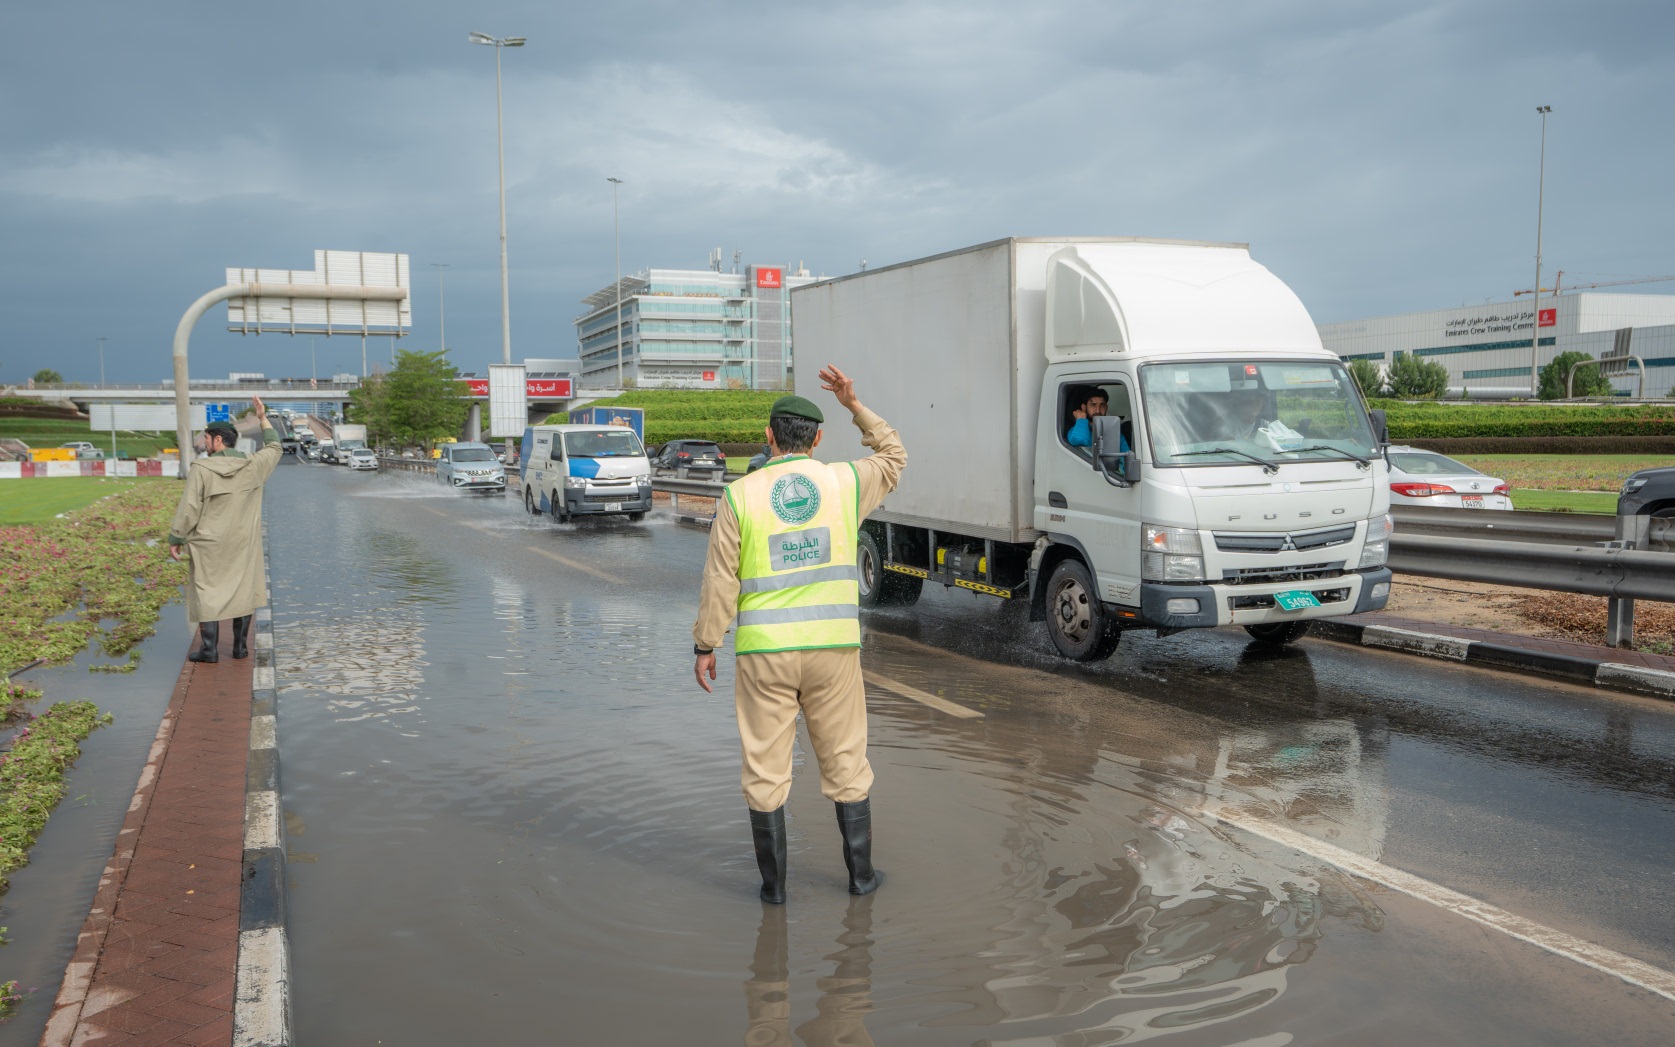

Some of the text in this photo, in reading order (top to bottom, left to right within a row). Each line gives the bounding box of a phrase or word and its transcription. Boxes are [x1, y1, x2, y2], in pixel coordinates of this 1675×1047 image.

[1484, 315, 1500, 325] طاقم
[1501, 313, 1519, 322] تدريب
[1520, 311, 1534, 320] مركز
[1467, 317, 1483, 326] طيران
[1445, 329, 1469, 337] Emirates
[1487, 324, 1511, 333] Training
[1513, 322, 1534, 330] Centre
[1227, 508, 1346, 521] FUSO
[782, 537, 818, 552] الشرطة
[784, 551, 820, 562] POLICE
[1286, 597, 1316, 608] 54962
